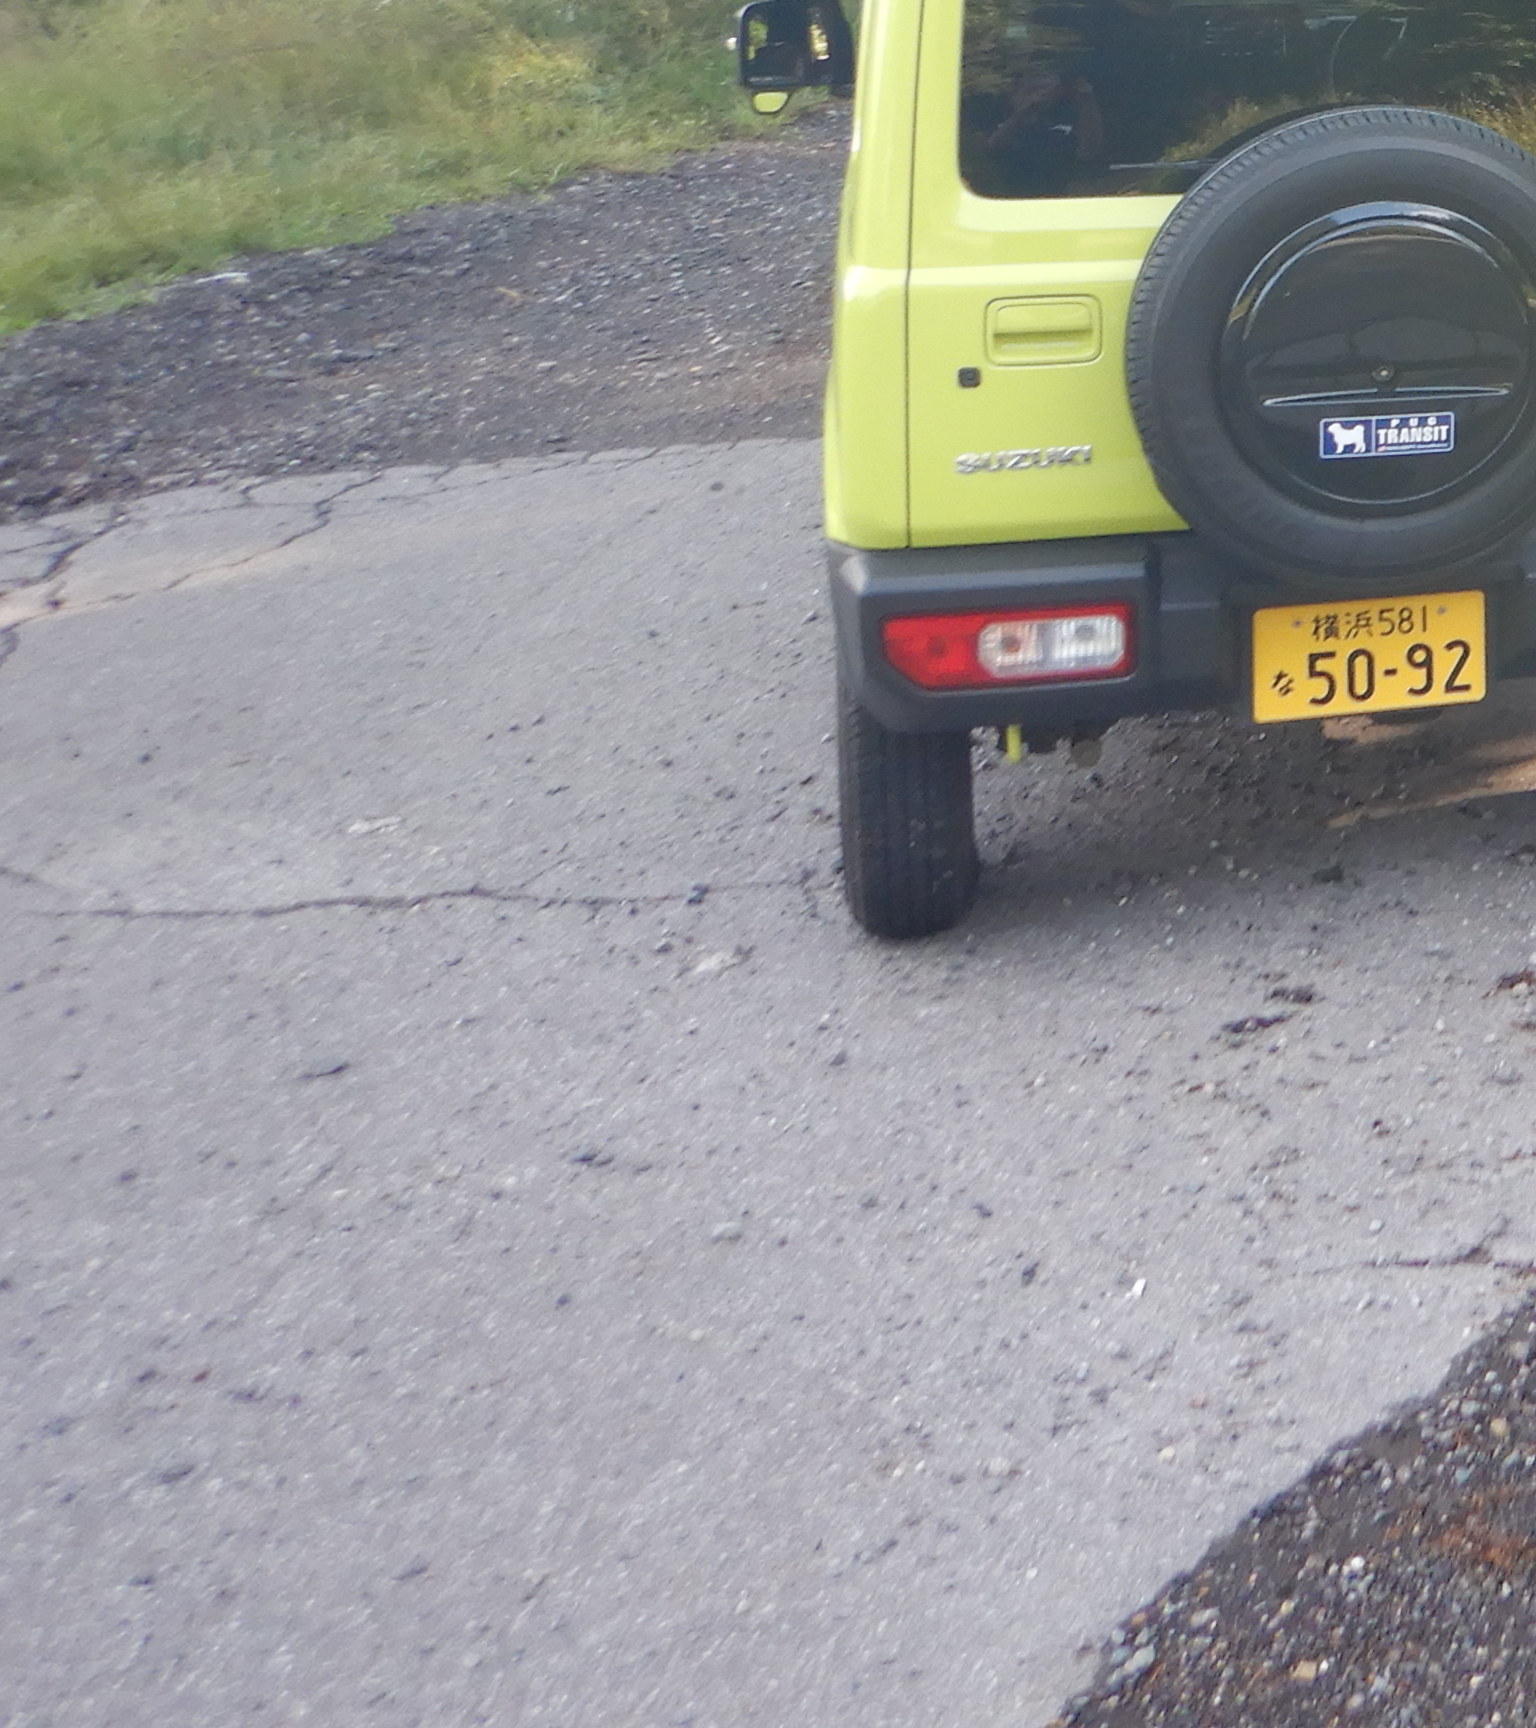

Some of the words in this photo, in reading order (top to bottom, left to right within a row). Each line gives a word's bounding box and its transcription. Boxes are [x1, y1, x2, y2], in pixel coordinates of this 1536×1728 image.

[1377, 425, 1449, 445] TRANSIT
[954, 444, 1093, 474] SUZUKI
[1271, 669, 1294, 697] な
[1307, 638, 1472, 706] 50-92
